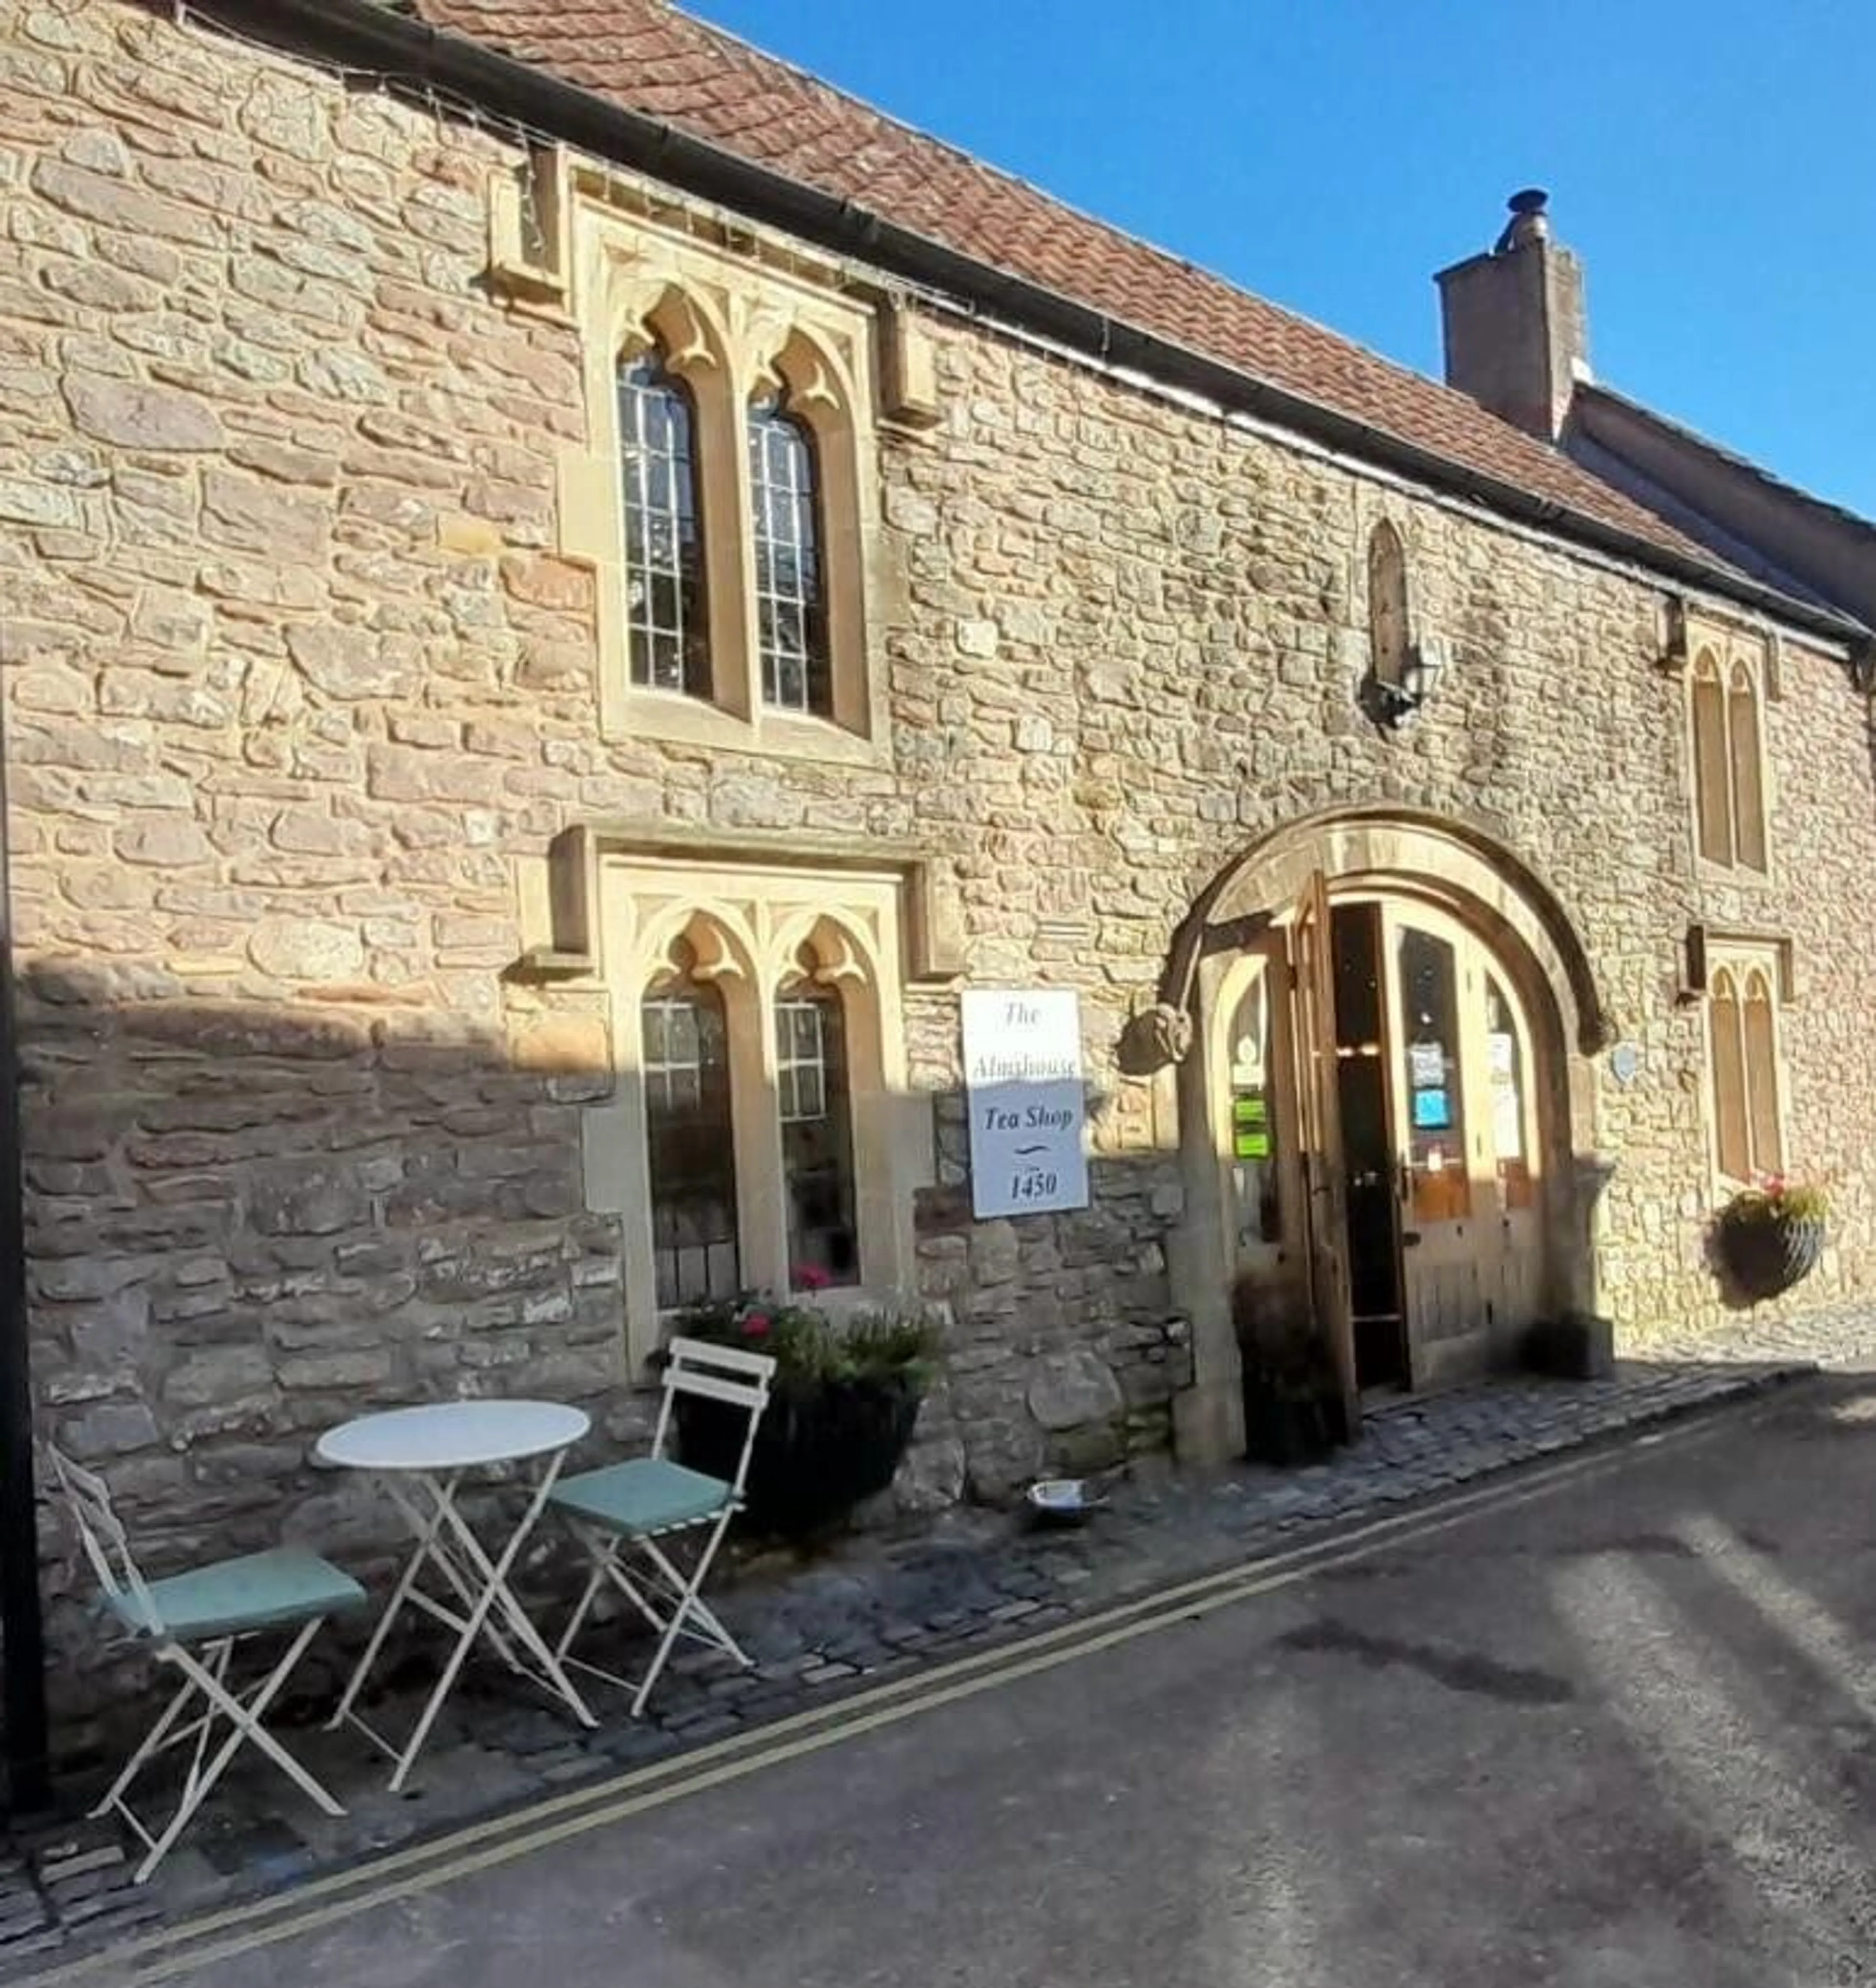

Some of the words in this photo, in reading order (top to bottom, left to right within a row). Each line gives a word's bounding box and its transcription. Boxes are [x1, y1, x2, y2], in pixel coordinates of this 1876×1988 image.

[1004, 1001, 1042, 1026] The
[985, 1106, 1020, 1130] Tea
[1026, 1104, 1074, 1131] Shop
[1012, 1172, 1057, 1199] 1450
